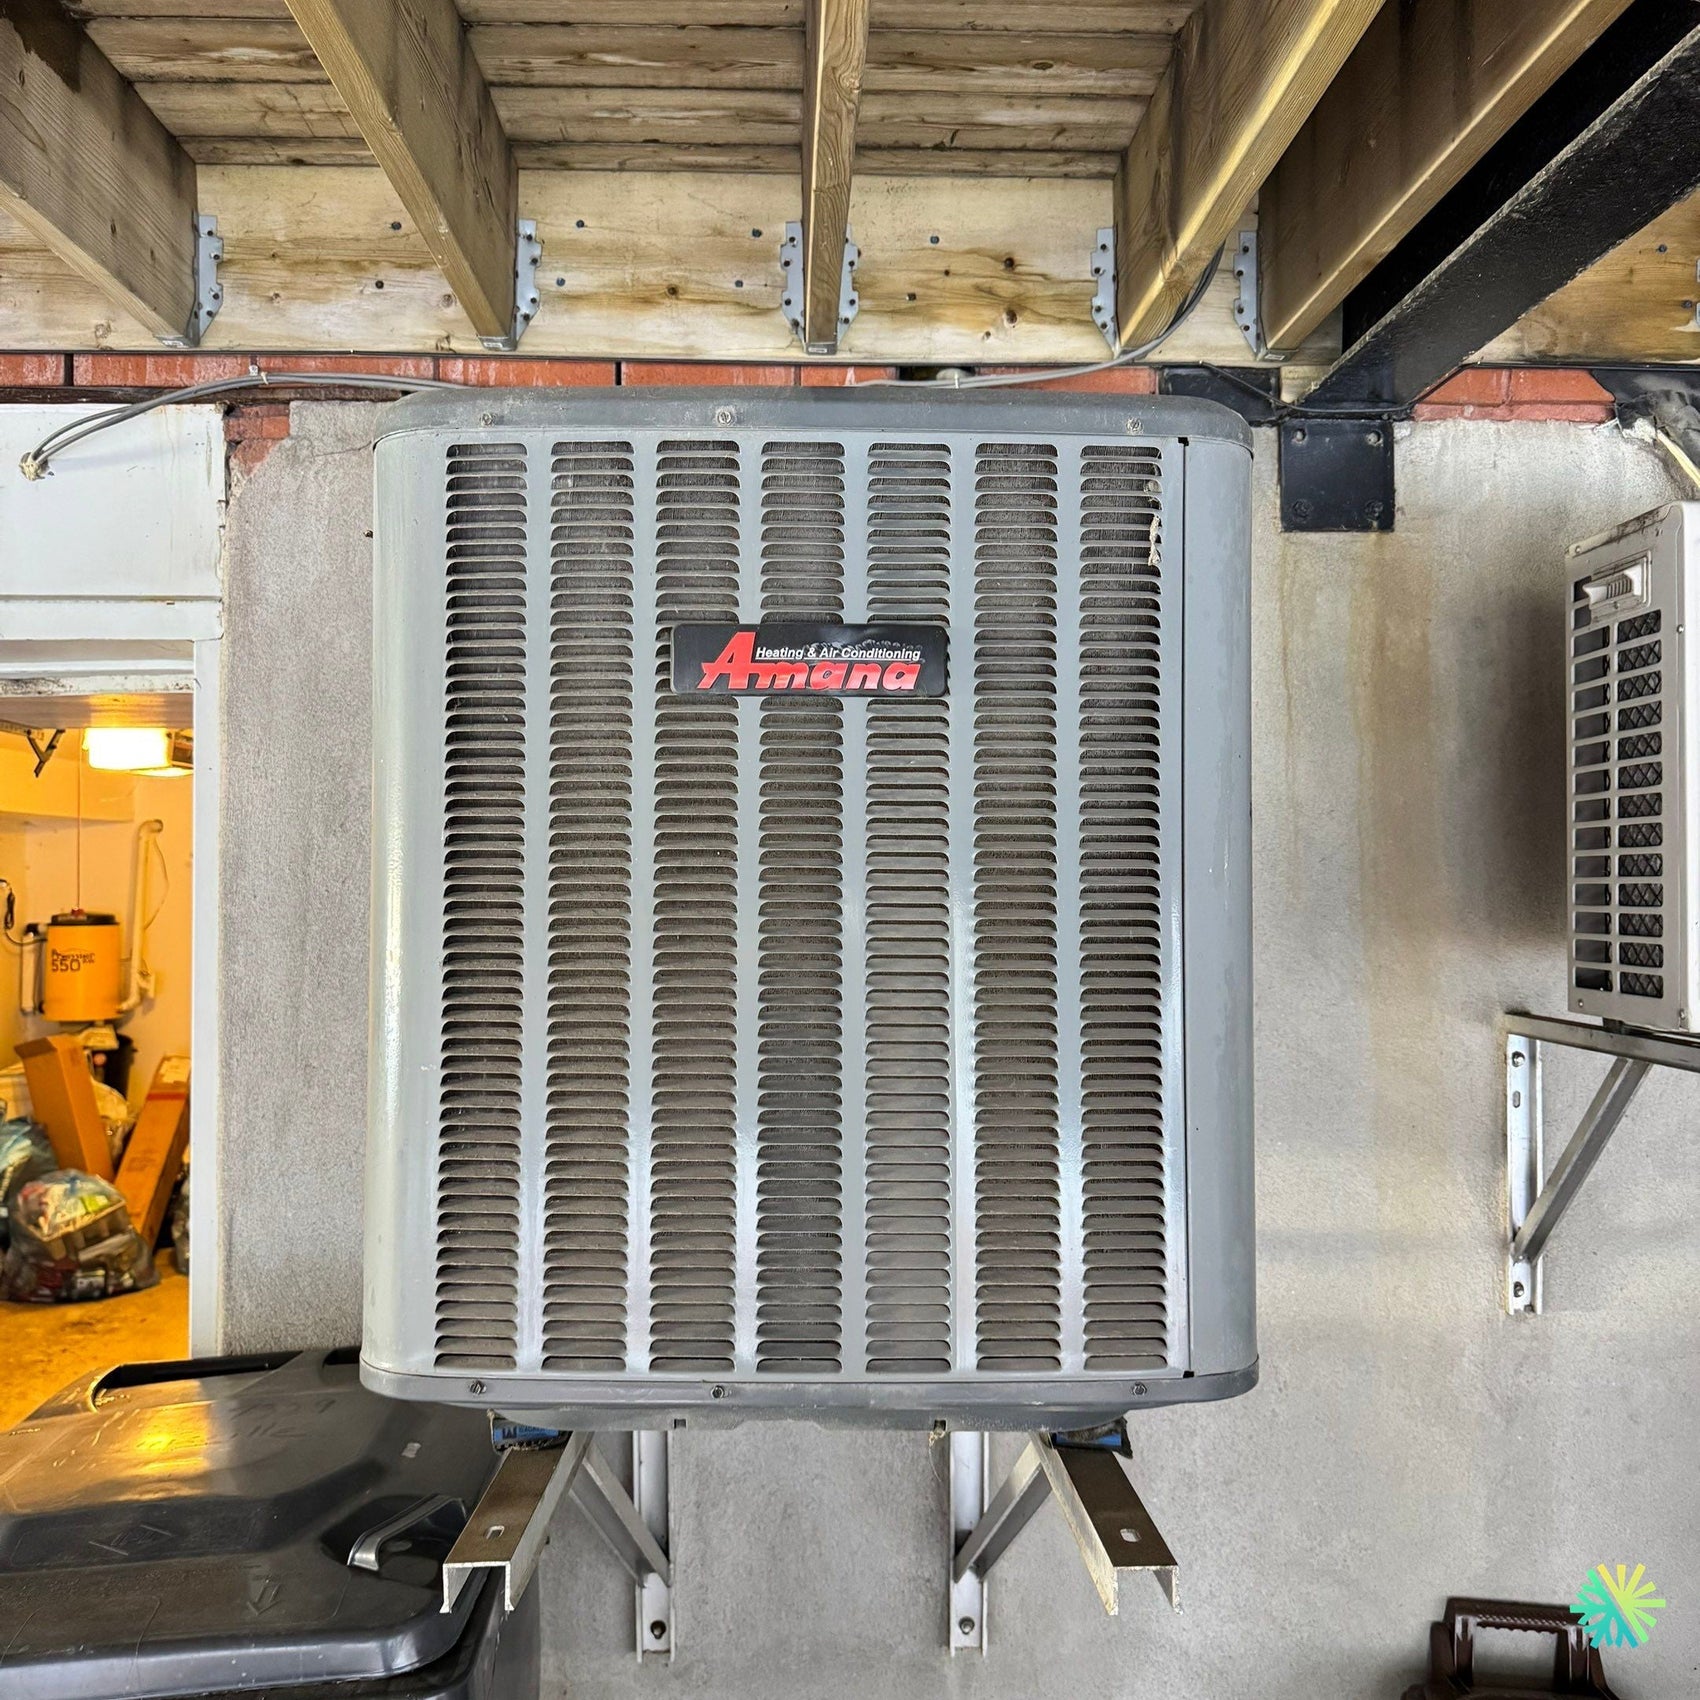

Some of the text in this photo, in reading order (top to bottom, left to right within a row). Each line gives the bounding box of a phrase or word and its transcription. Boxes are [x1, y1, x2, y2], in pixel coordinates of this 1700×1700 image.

[755, 646, 921, 661] Heating & Air Conditioning
[697, 631, 922, 692] Amana
[51, 958, 81, 972] 550
